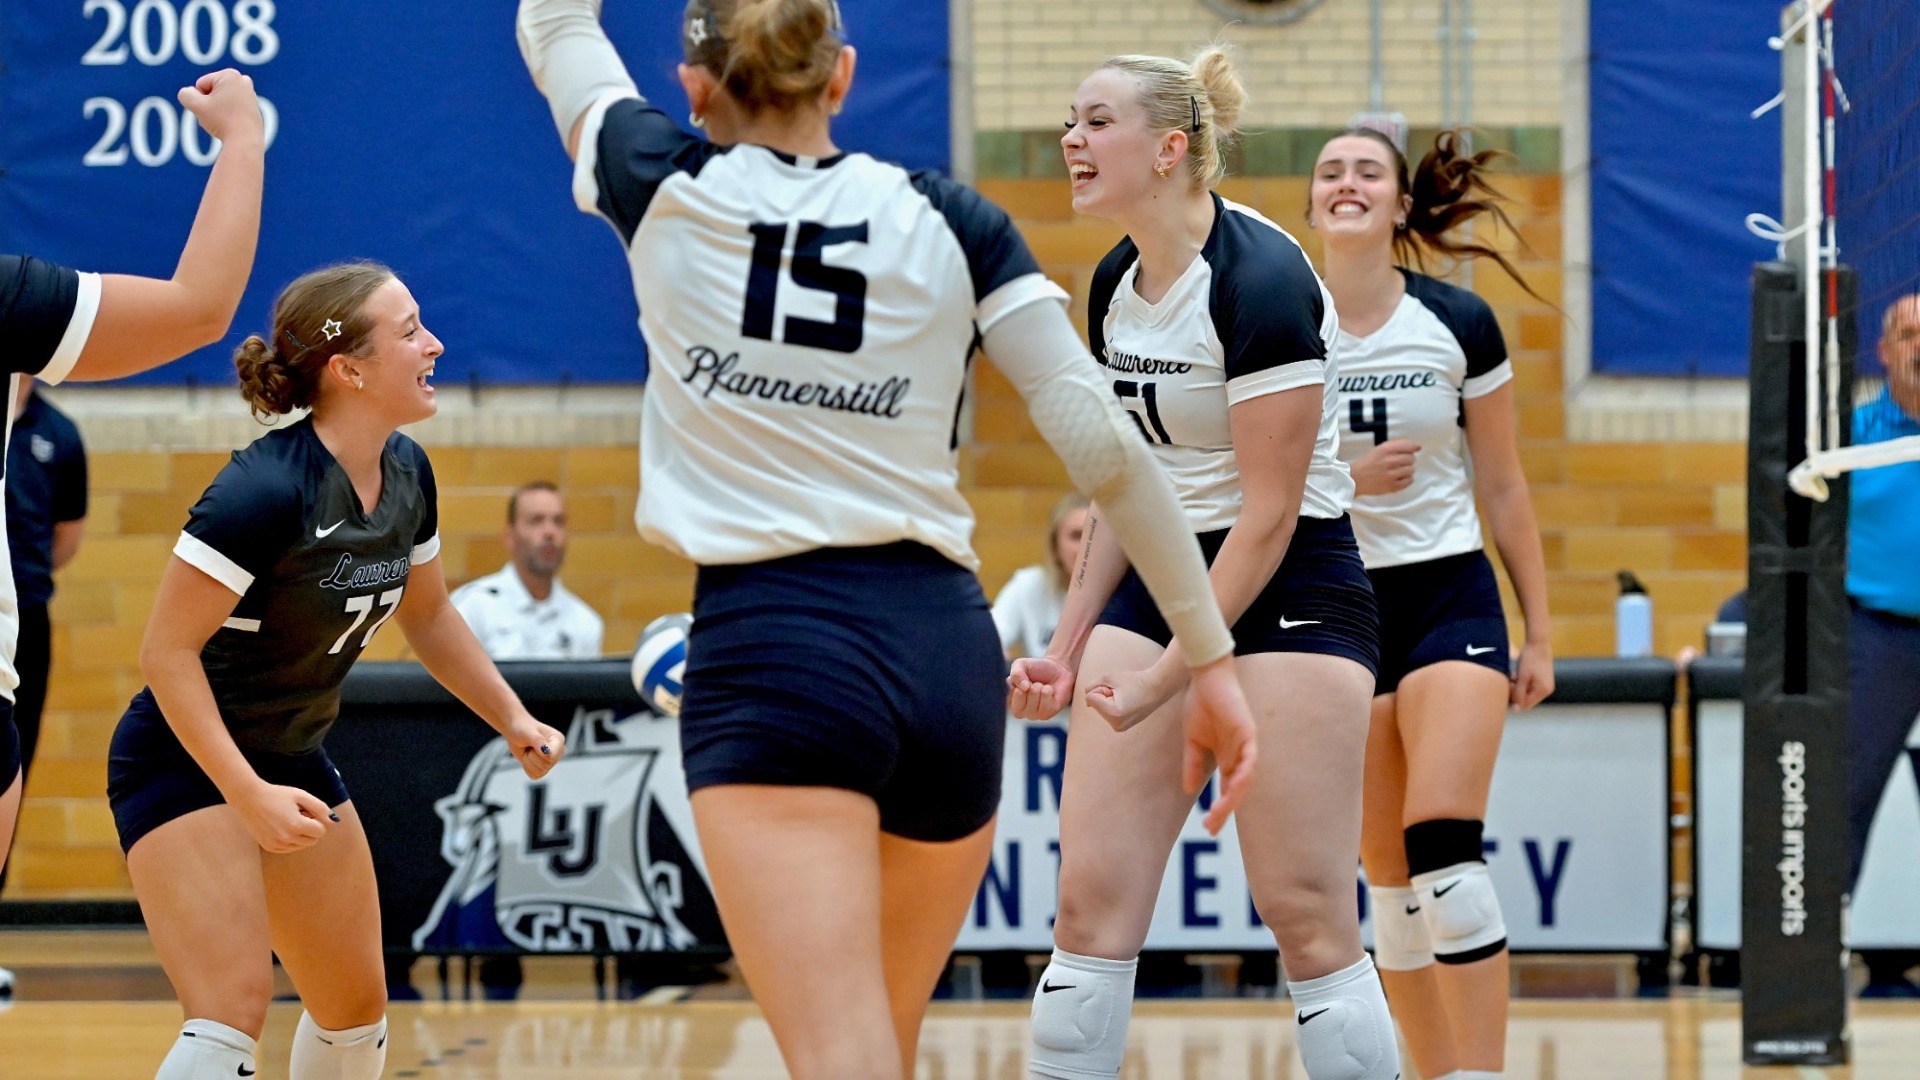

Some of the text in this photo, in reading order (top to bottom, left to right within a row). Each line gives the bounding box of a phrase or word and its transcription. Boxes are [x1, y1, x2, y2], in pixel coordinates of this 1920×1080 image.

[80, 0, 280, 66] 2008
[741, 219, 869, 353] 15
[682, 345, 910, 419] Pfannerstill
[1338, 371, 1435, 392] wrence
[1349, 398, 1387, 445] 4
[319, 552, 412, 590] Lawren
[327, 586, 404, 655] 77
